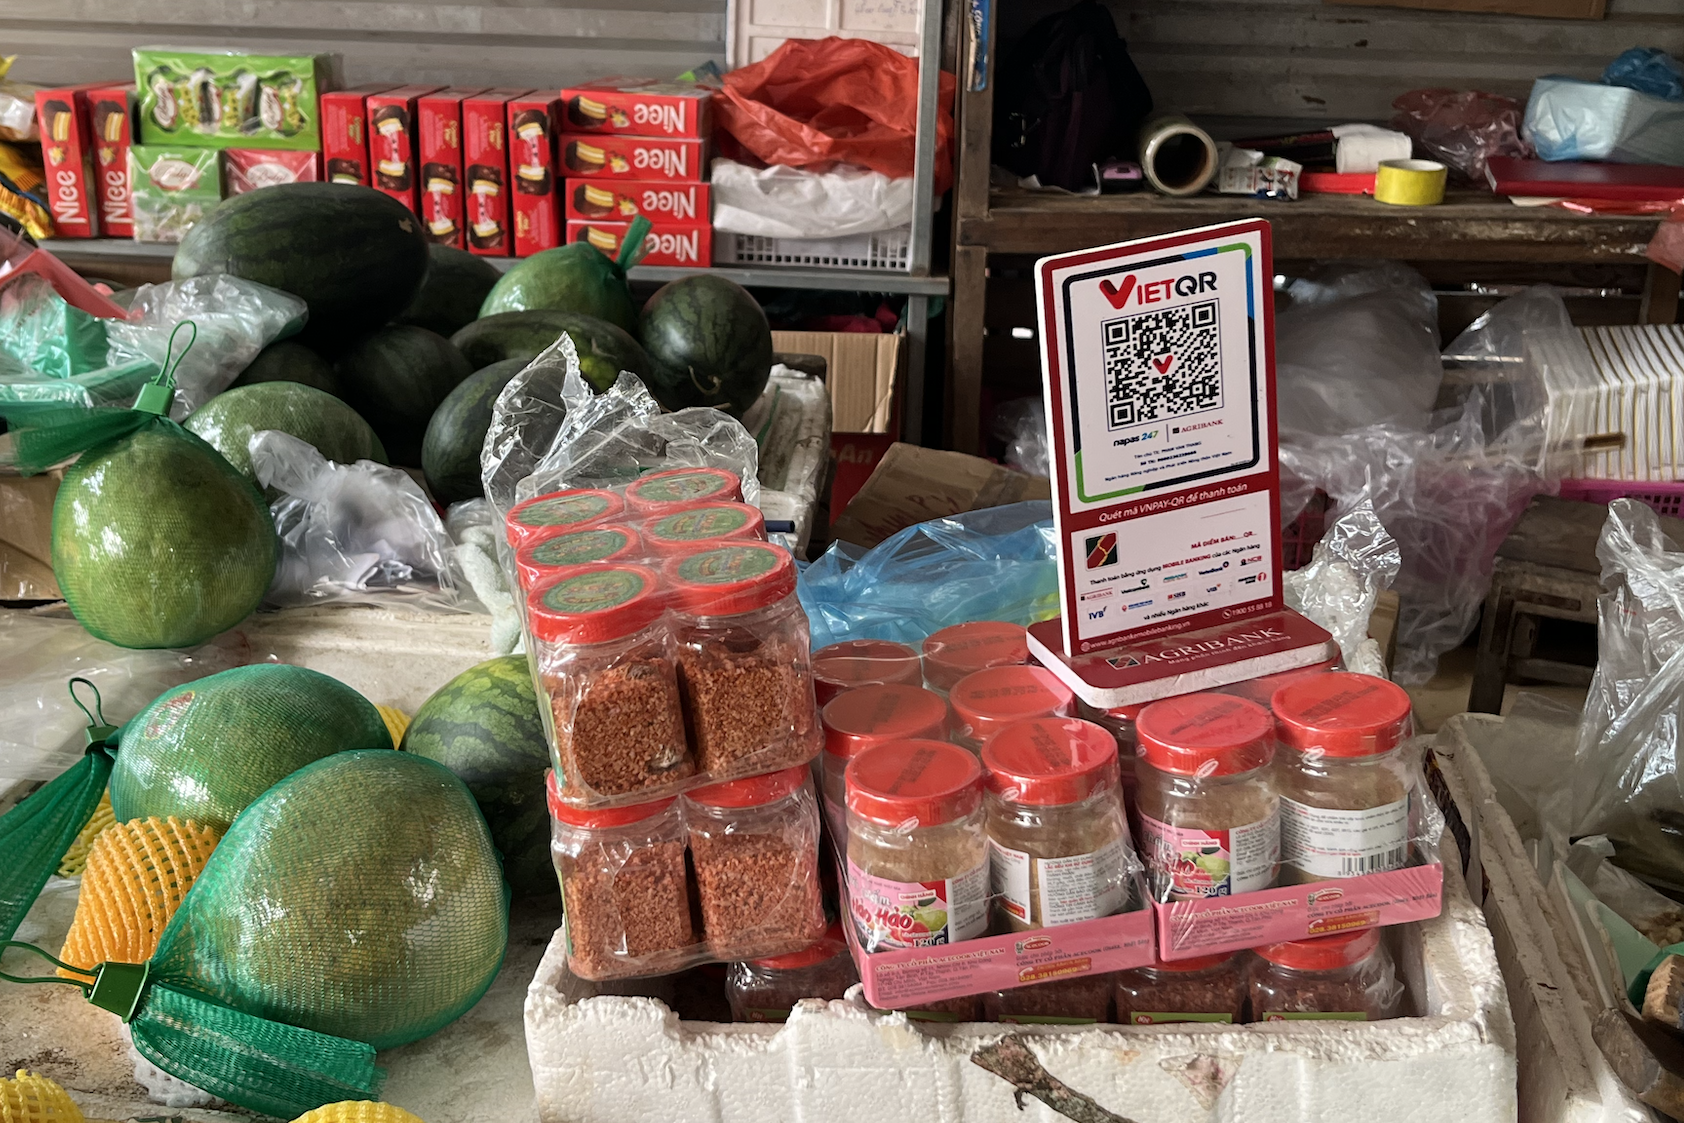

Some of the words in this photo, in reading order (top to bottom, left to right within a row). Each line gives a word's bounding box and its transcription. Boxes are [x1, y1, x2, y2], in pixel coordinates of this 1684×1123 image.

[633, 100, 686, 133] Nice
[633, 144, 687, 178] Nice
[53, 170, 87, 224] Nice
[102, 170, 134, 224] Nice
[642, 186, 696, 219] Nice
[645, 230, 699, 262] Nice
[1098, 271, 1218, 310] VIETQR
[1181, 419, 1224, 433] AGRIBANK
[1113, 435, 1140, 447] napas
[1141, 430, 1159, 441] 247
[1099, 510, 1122, 522] Quét
[1123, 507, 1138, 517] mã
[1140, 495, 1185, 513] VNPAY-QR
[1186, 492, 1198, 503] để
[1200, 488, 1226, 500] thanh
[1227, 483, 1248, 494] toán
[1191, 541, 1202, 549] MÃ
[1090, 577, 1107, 585] Thanh
[1147, 565, 1162, 573] dụng
[1162, 560, 1184, 569] MOBILE
[1185, 553, 1211, 564] BANKING
[1088, 610, 1105, 620] IVB
[1151, 610, 1166, 619] nhiều
[1167, 607, 1181, 616] Ngân
[1182, 605, 1196, 613] hàng
[1232, 606, 1247, 616] 1900
[1247, 605, 1255, 613] 55
[1264, 601, 1273, 609] 18
[1144, 627, 1283, 665] AGRIBANK
[1168, 656, 1190, 665] Mang
[1195, 885, 1216, 895] 120
[874, 906, 914, 929] Hảo
[1211, 907, 1231, 916] PHẦN
[1233, 904, 1263, 914] ACECOOK
[1264, 901, 1281, 910] VIỆT
[1282, 899, 1297, 907] NAM
[1307, 911, 1324, 919] CÔNG
[1344, 905, 1361, 913] PHẦN
[1362, 901, 1391, 910] ACECOOK
[876, 963, 895, 972] CÔNG
[906, 958, 917, 968] CỔ
[918, 956, 938, 966] PHẦN
[940, 953, 970, 963] ACECOOK
[972, 949, 989, 959] VIỆT
[990, 948, 1005, 956] NAM
[1016, 959, 1034, 967] CÔNG
[1043, 955, 1053, 963] CỔ
[1054, 952, 1072, 961] PHẦN
[1073, 948, 1102, 957] ACECOOK
